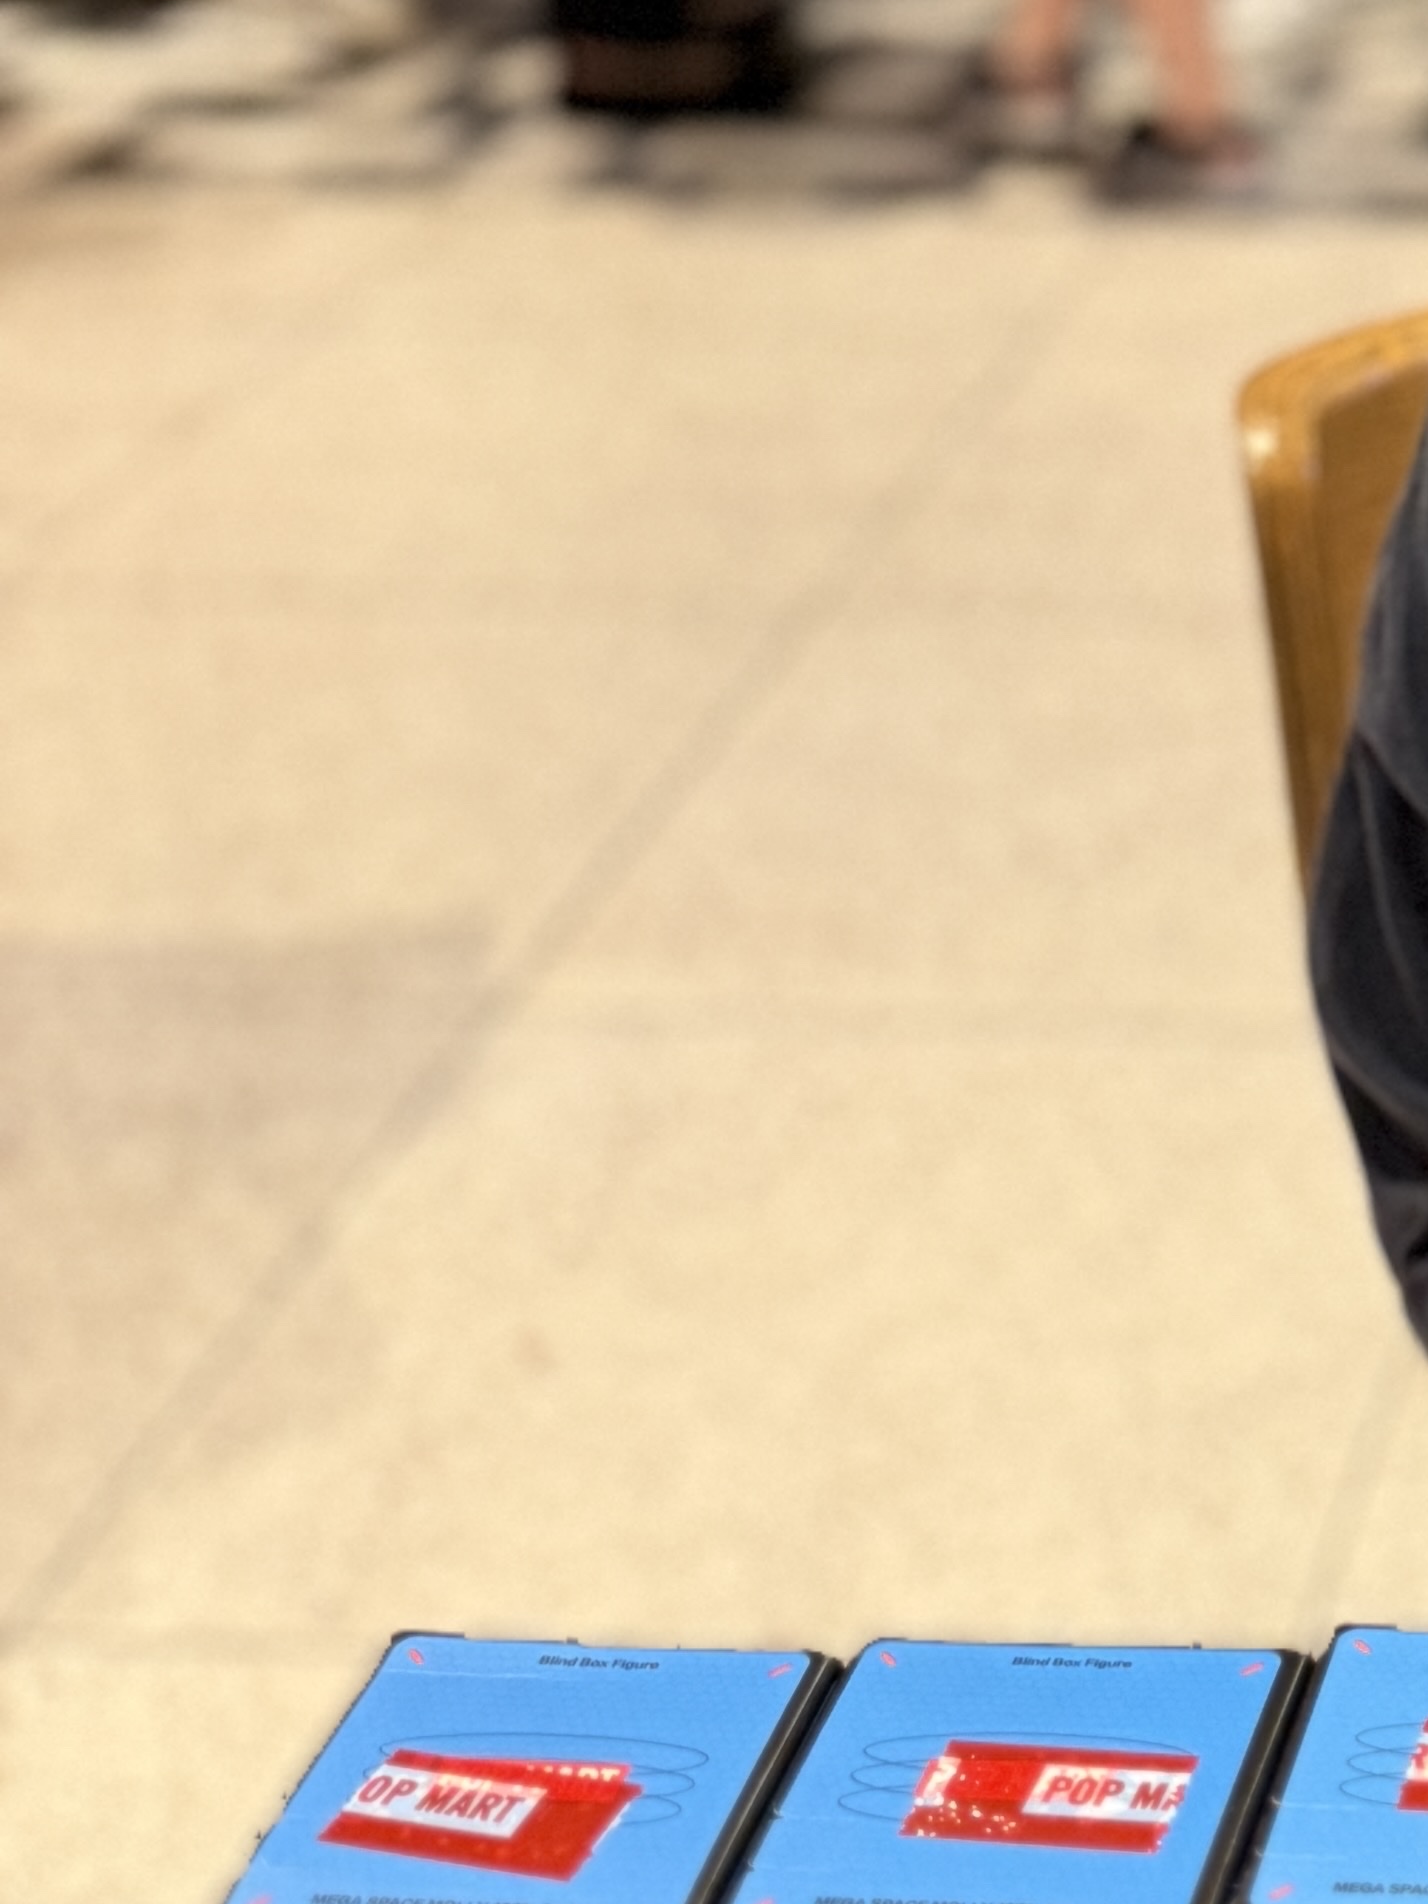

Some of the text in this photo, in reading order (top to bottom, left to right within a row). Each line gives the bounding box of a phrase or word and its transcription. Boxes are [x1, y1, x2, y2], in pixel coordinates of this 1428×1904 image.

[538, 1654, 660, 1671] Blind Box Figure
[1011, 1656, 1132, 1669] Blind Box Figure
[1042, 1774, 1124, 1809] POP
[414, 1784, 527, 1823] MART
[1333, 1882, 1384, 1894] MEGA
